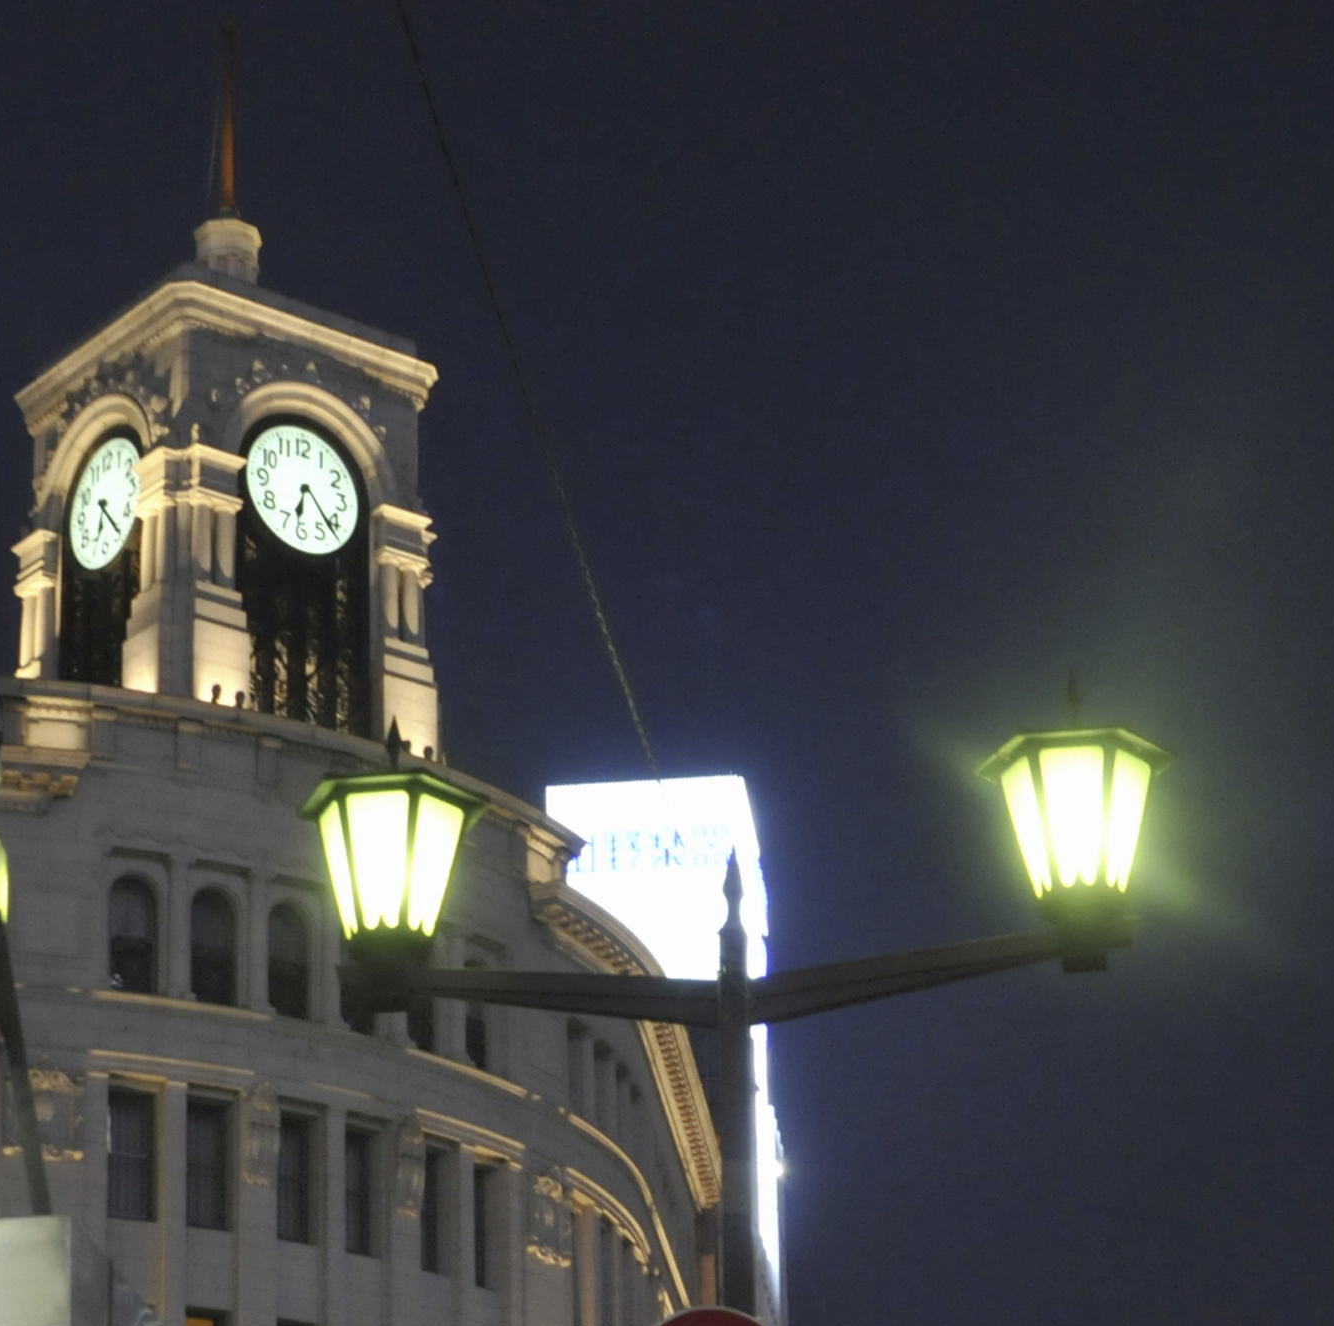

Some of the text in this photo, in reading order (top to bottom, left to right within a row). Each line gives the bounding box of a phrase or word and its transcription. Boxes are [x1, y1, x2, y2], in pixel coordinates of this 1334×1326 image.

[278, 437, 290, 457] 11
[295, 438, 311, 459] 12
[262, 449, 277, 469] 10
[319, 452, 324, 469] 1
[256, 468, 270, 486] 9
[329, 469, 341, 489] 2
[262, 490, 276, 510] 8
[335, 492, 347, 512] 3
[279, 509, 291, 529] 7
[314, 521, 326, 541] 5
